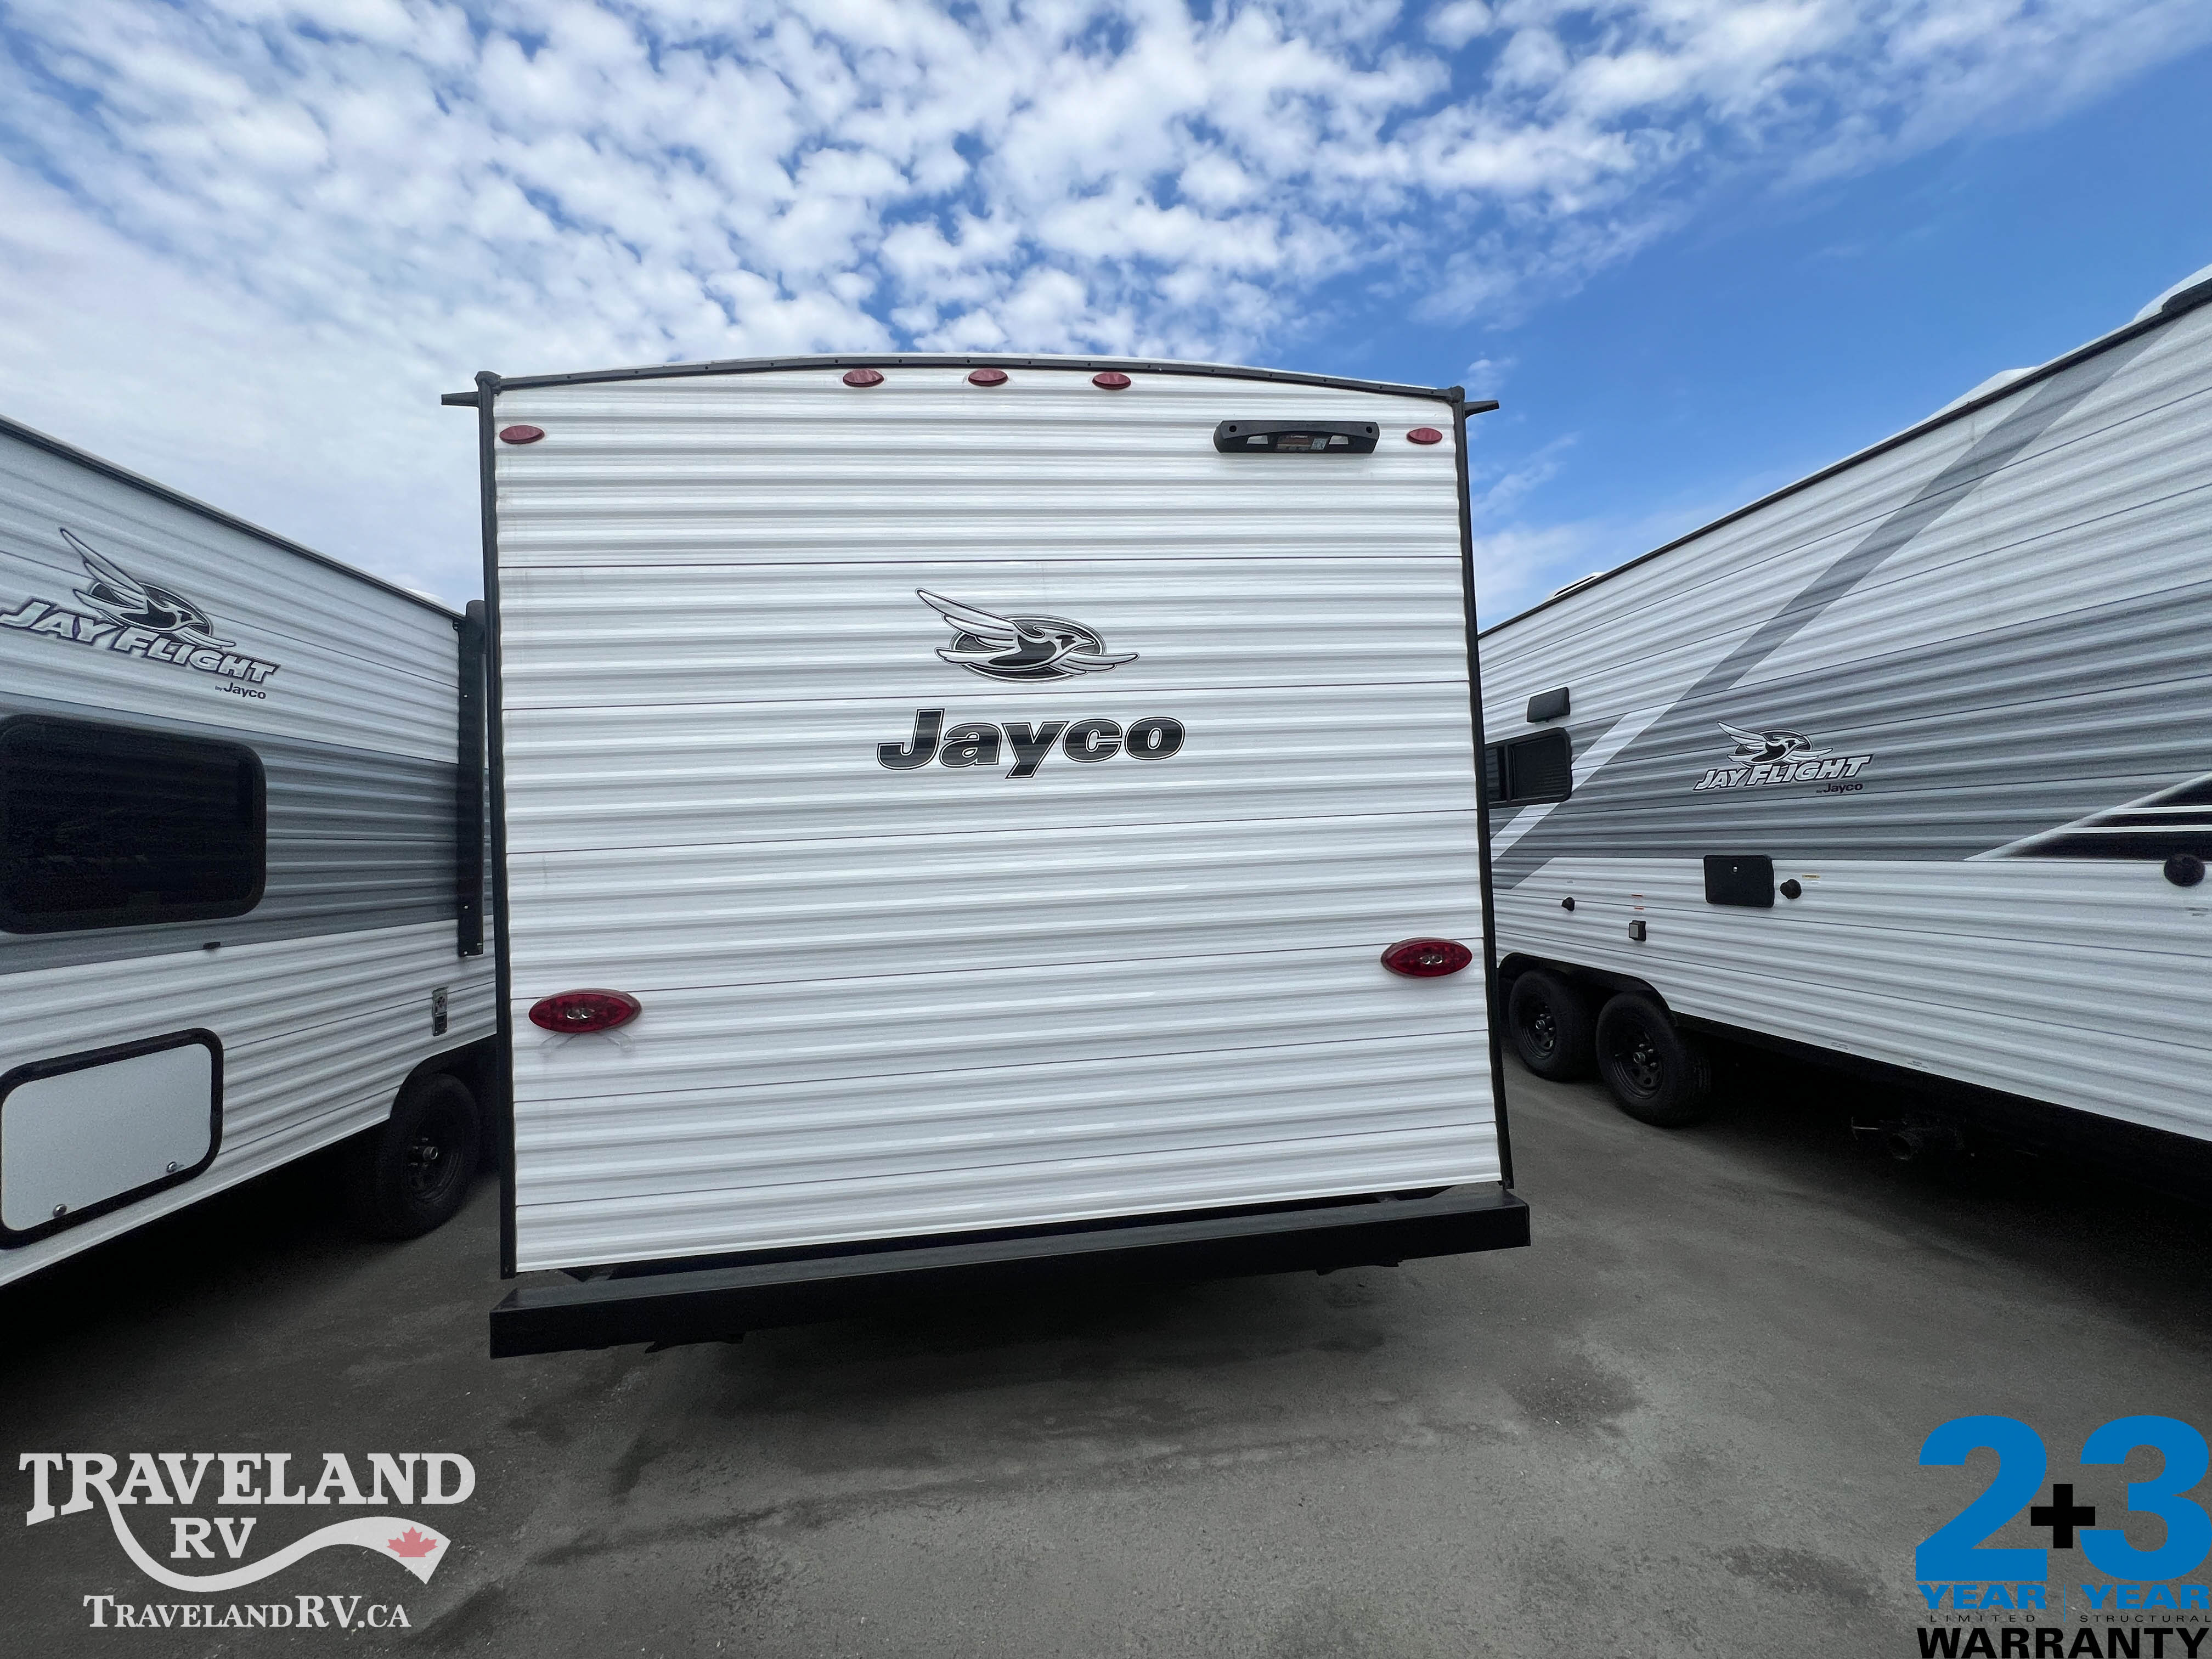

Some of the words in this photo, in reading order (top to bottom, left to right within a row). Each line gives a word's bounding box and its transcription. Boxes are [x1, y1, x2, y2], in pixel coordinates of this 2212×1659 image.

[0, 596, 117, 645] JAY
[108, 626, 280, 684] FLIGHT
[223, 682, 266, 699] Jayco
[877, 708, 1185, 779] Jayco
[1692, 769, 1748, 791] JAY
[1745, 754, 1874, 786] FLIGHT
[1823, 783, 1863, 793] Jayco
